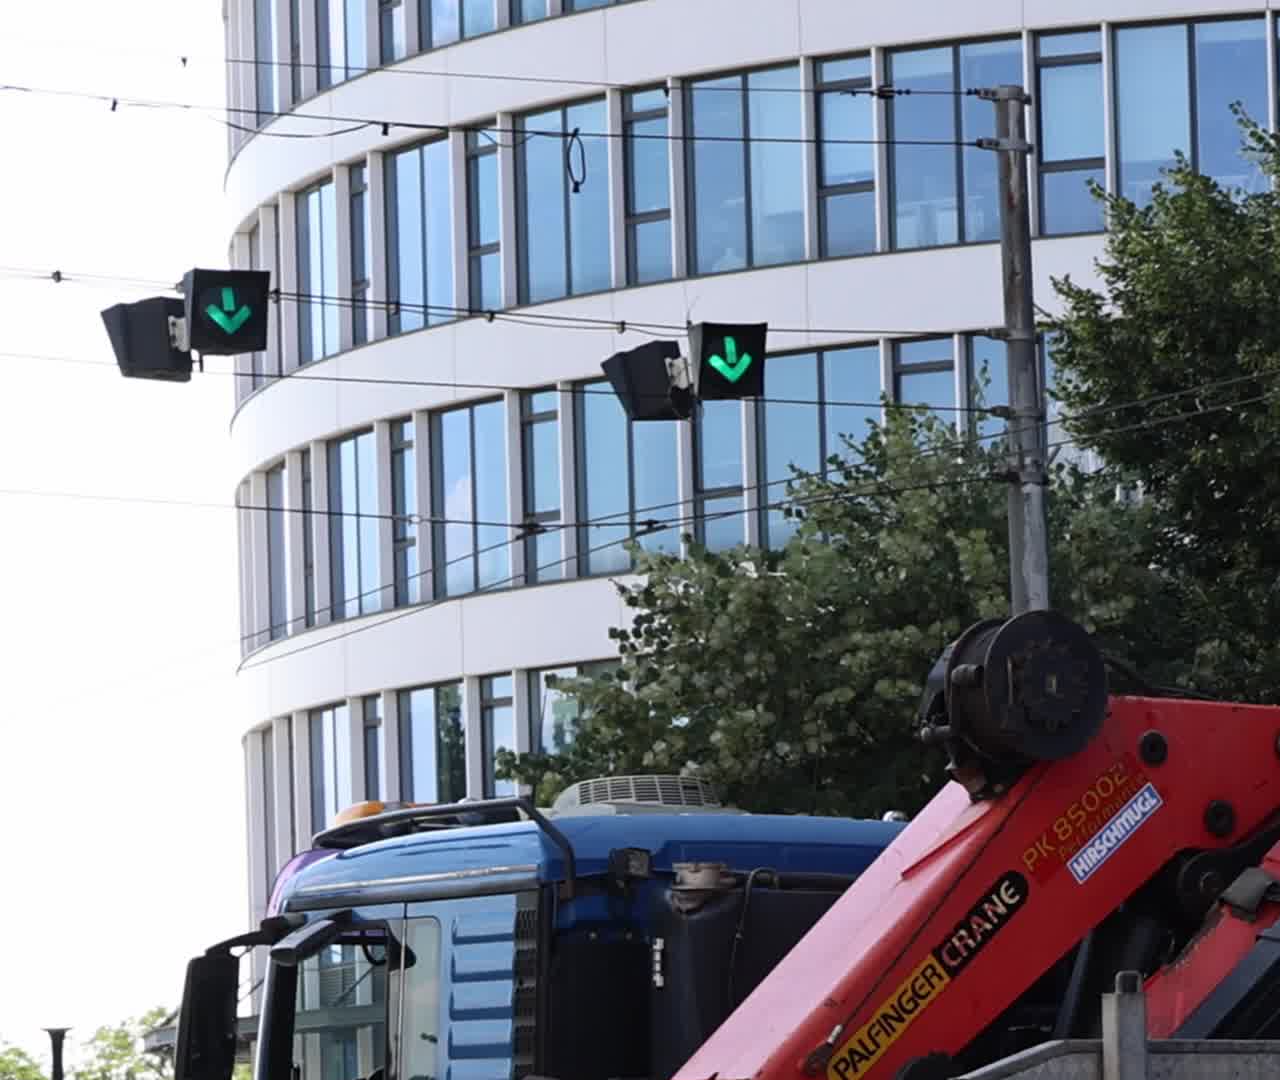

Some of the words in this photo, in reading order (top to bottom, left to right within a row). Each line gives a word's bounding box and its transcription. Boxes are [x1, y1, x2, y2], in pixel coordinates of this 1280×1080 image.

[1023, 832, 1055, 872] PK
[1053, 762, 1129, 842] 85002
[1071, 790, 1158, 878] HIRSCHMUGL
[941, 879, 1021, 967] CRANE
